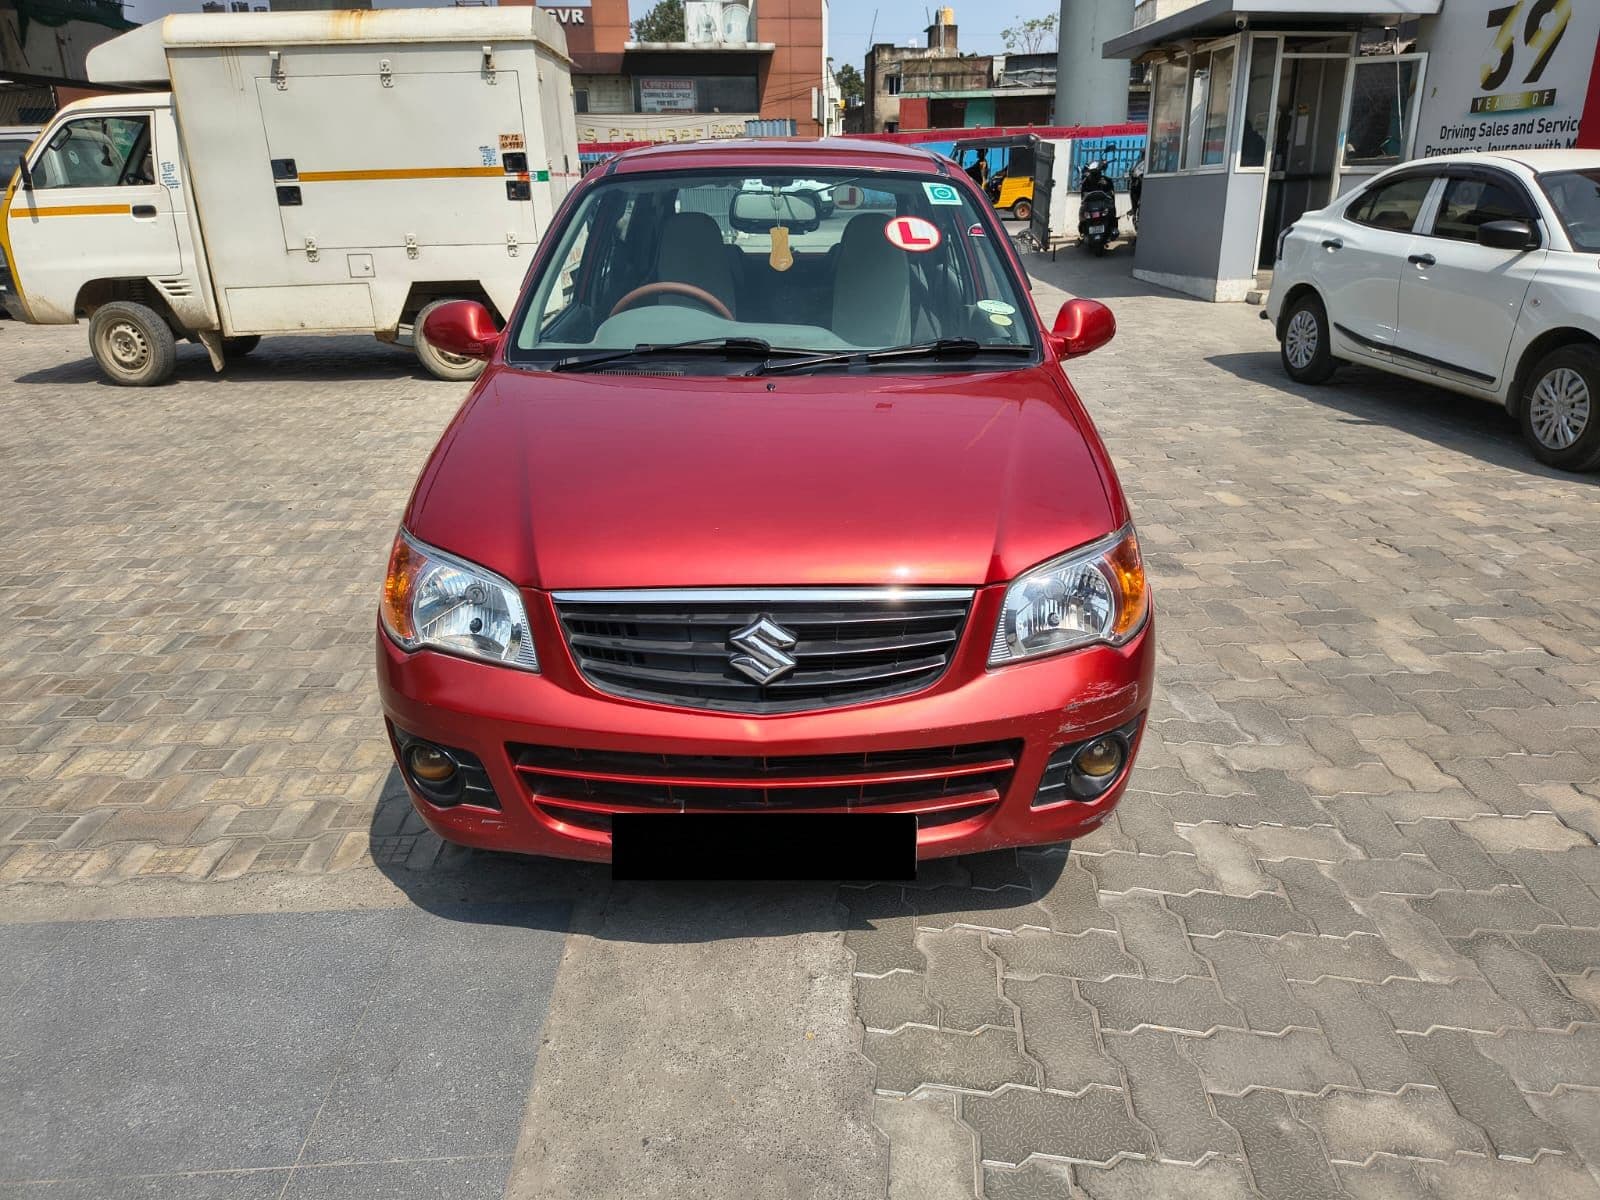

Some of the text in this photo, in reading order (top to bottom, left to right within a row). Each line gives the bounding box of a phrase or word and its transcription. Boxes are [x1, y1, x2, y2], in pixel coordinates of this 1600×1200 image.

[1481, 0, 1571, 91] 39
[1532, 92, 1550, 105] OF
[1440, 123, 1476, 141] Driving
[1479, 121, 1509, 137] Sales
[1511, 118, 1535, 135] and
[898, 222, 931, 244] L
